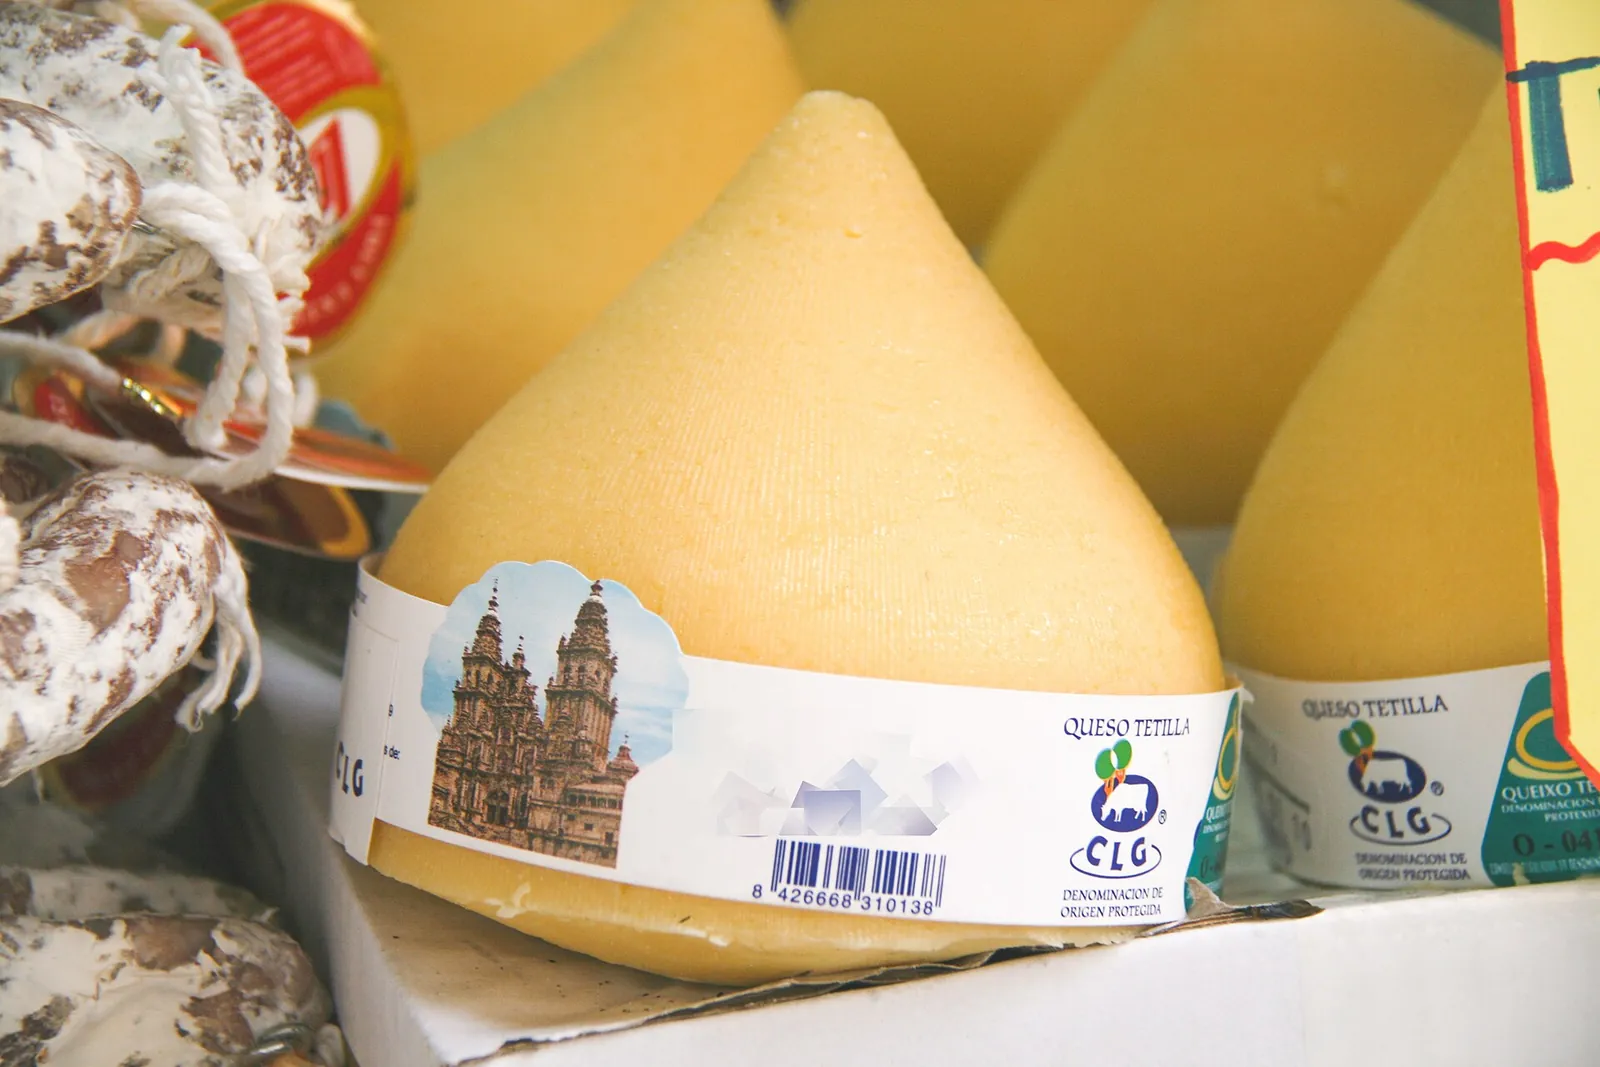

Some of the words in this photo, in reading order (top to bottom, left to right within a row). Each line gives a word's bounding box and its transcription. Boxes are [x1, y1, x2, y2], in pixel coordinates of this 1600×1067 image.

[1506, 56, 1600, 193] T
[1303, 698, 1361, 721] QUESO
[1363, 694, 1449, 718] TETILLA
[1063, 717, 1130, 740] QUESO
[1134, 717, 1190, 737] TETILLA
[1501, 781, 1572, 804] QUEIXO
[1501, 798, 1595, 814] DENOMINACION
[1361, 804, 1431, 839] CLG
[1086, 835, 1147, 871] CLG
[1355, 852, 1447, 865] DENOMINACION
[1450, 852, 1468, 865] DE
[1358, 869, 1400, 881] ORIGEN
[1403, 867, 1472, 881] PROTEGIDA
[752, 884, 763, 899] 8
[777, 887, 853, 909] 426668
[860, 895, 934, 916] 310138
[1063, 887, 1150, 901] DENOMINACION
[1152, 886, 1164, 899] DE
[1060, 905, 1106, 918] ORIGEN
[1108, 903, 1162, 918] PROTEGIDA
